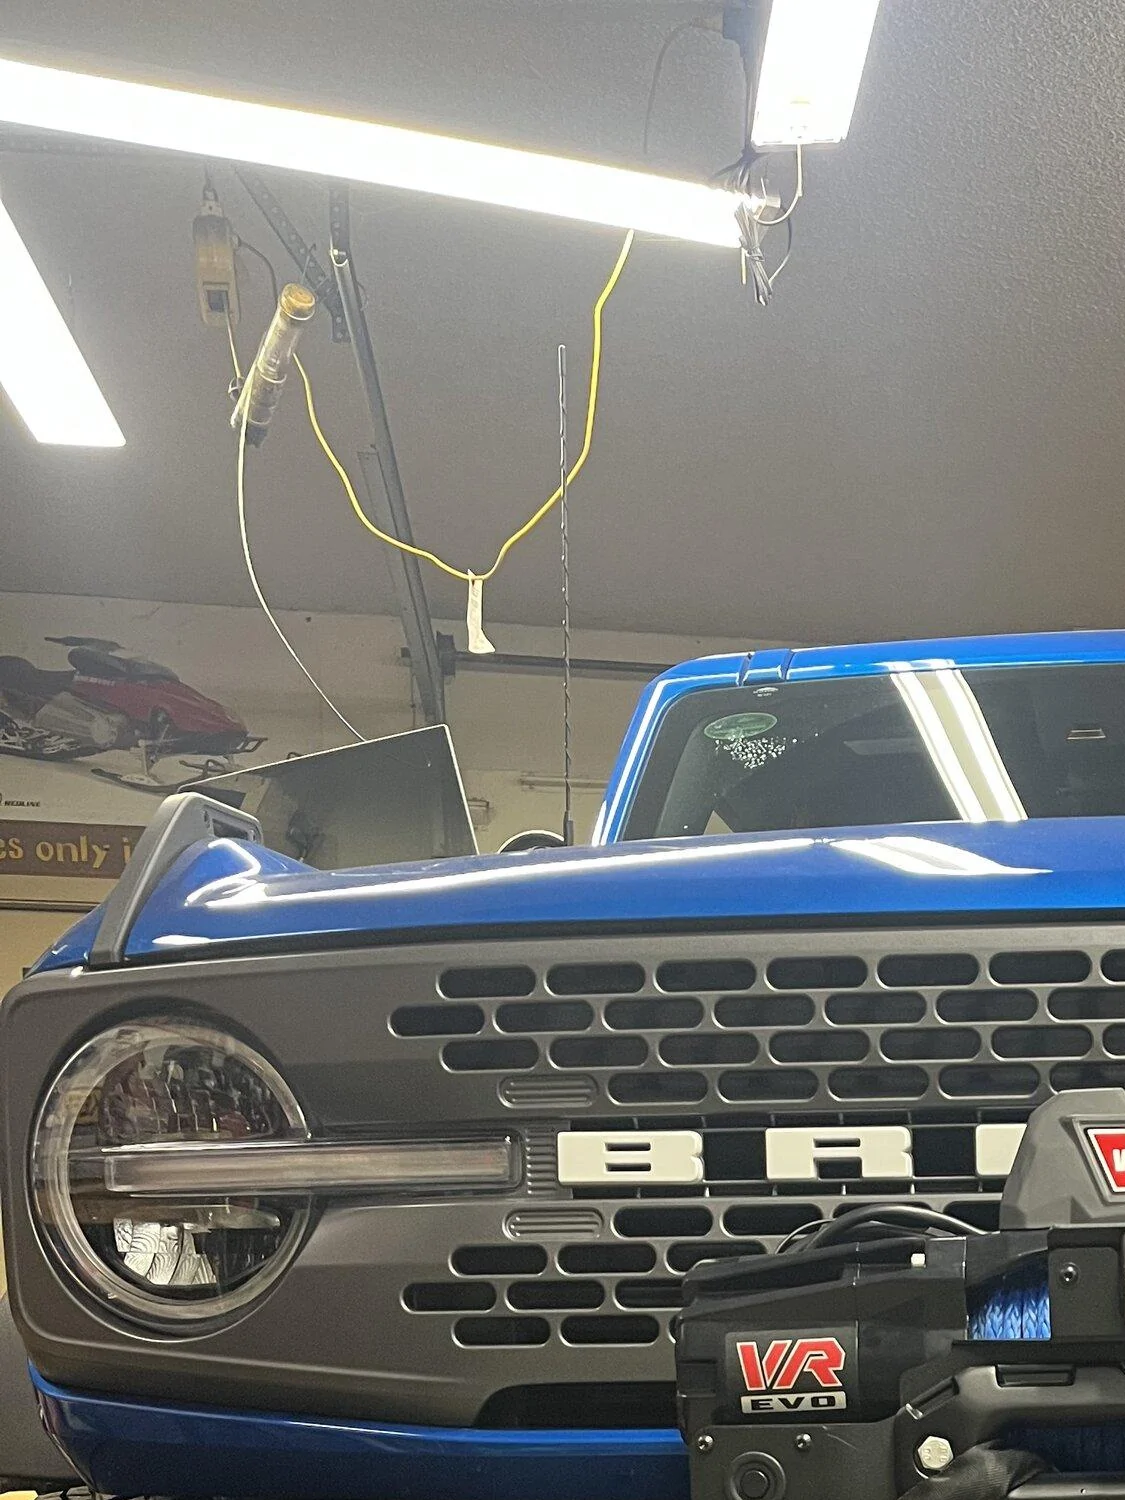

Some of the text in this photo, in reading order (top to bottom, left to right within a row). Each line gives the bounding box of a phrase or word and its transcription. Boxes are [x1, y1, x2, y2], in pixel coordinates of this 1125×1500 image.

[35, 835, 110, 869] only
[736, 1337, 846, 1391] VR
[750, 1395, 836, 1411] EVO
